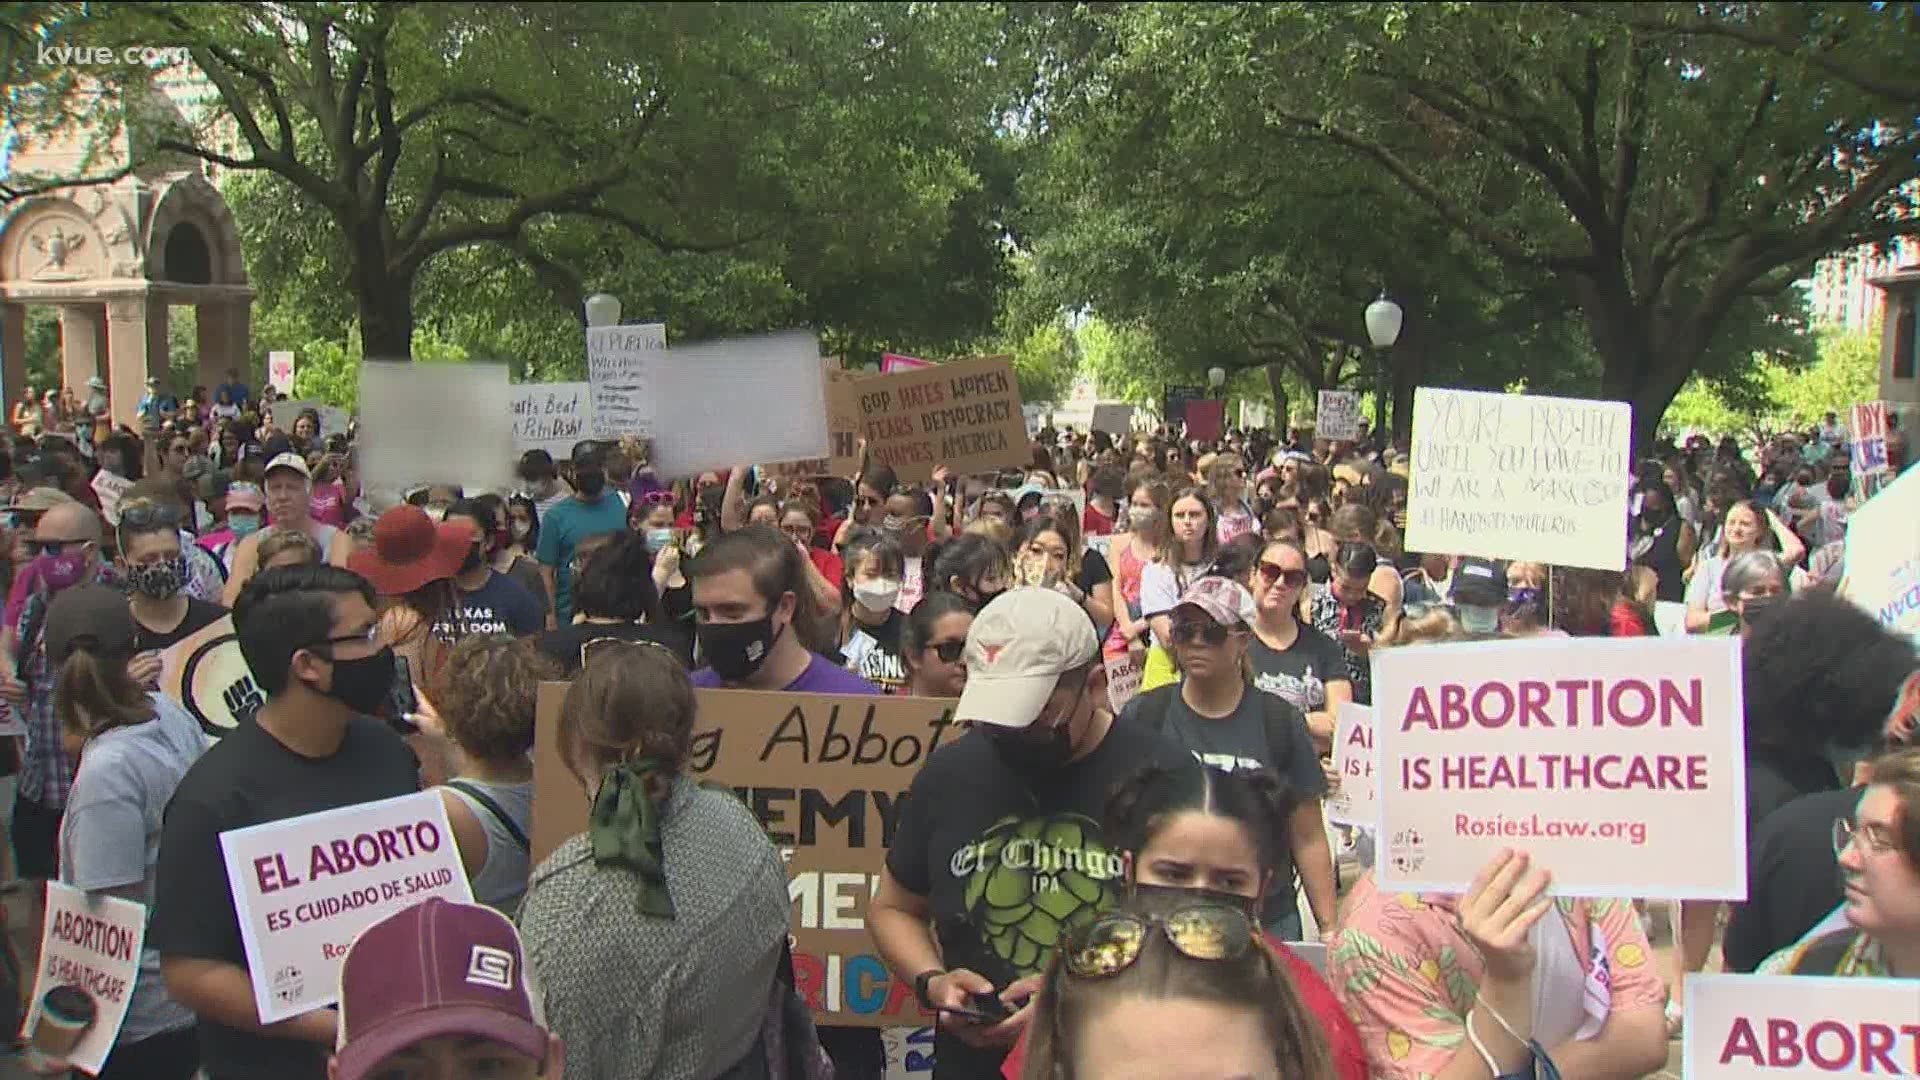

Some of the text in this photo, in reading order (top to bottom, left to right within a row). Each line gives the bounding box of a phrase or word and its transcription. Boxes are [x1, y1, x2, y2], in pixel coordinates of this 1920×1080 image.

[544, 391, 578, 415] Beat
[861, 370, 1009, 414] GOP HATES WOMEN
[868, 416, 914, 442] FEARS
[920, 399, 1011, 433] DEMOCRACY
[875, 441, 934, 467] SHAMES
[941, 429, 1008, 459] AMERICA
[1401, 678, 1704, 732] ABORTION
[759, 703, 953, 768] Abbot
[1402, 756, 1433, 790] IS
[1442, 754, 1709, 790] HEALTHCARE
[735, 786, 912, 849] EMY
[1455, 813, 1647, 844] RosiesLaw.org
[254, 820, 440, 894] EL ABORTO
[950, 838, 1124, 880] El Chingó
[267, 867, 452, 932] ES CUIDADO DE SALUD
[1032, 876, 1059, 893] IPA
[53, 910, 133, 961] ABORTION
[58, 958, 126, 1003] HEALTHCARE
[1719, 1017, 1920, 1076] ABORT
